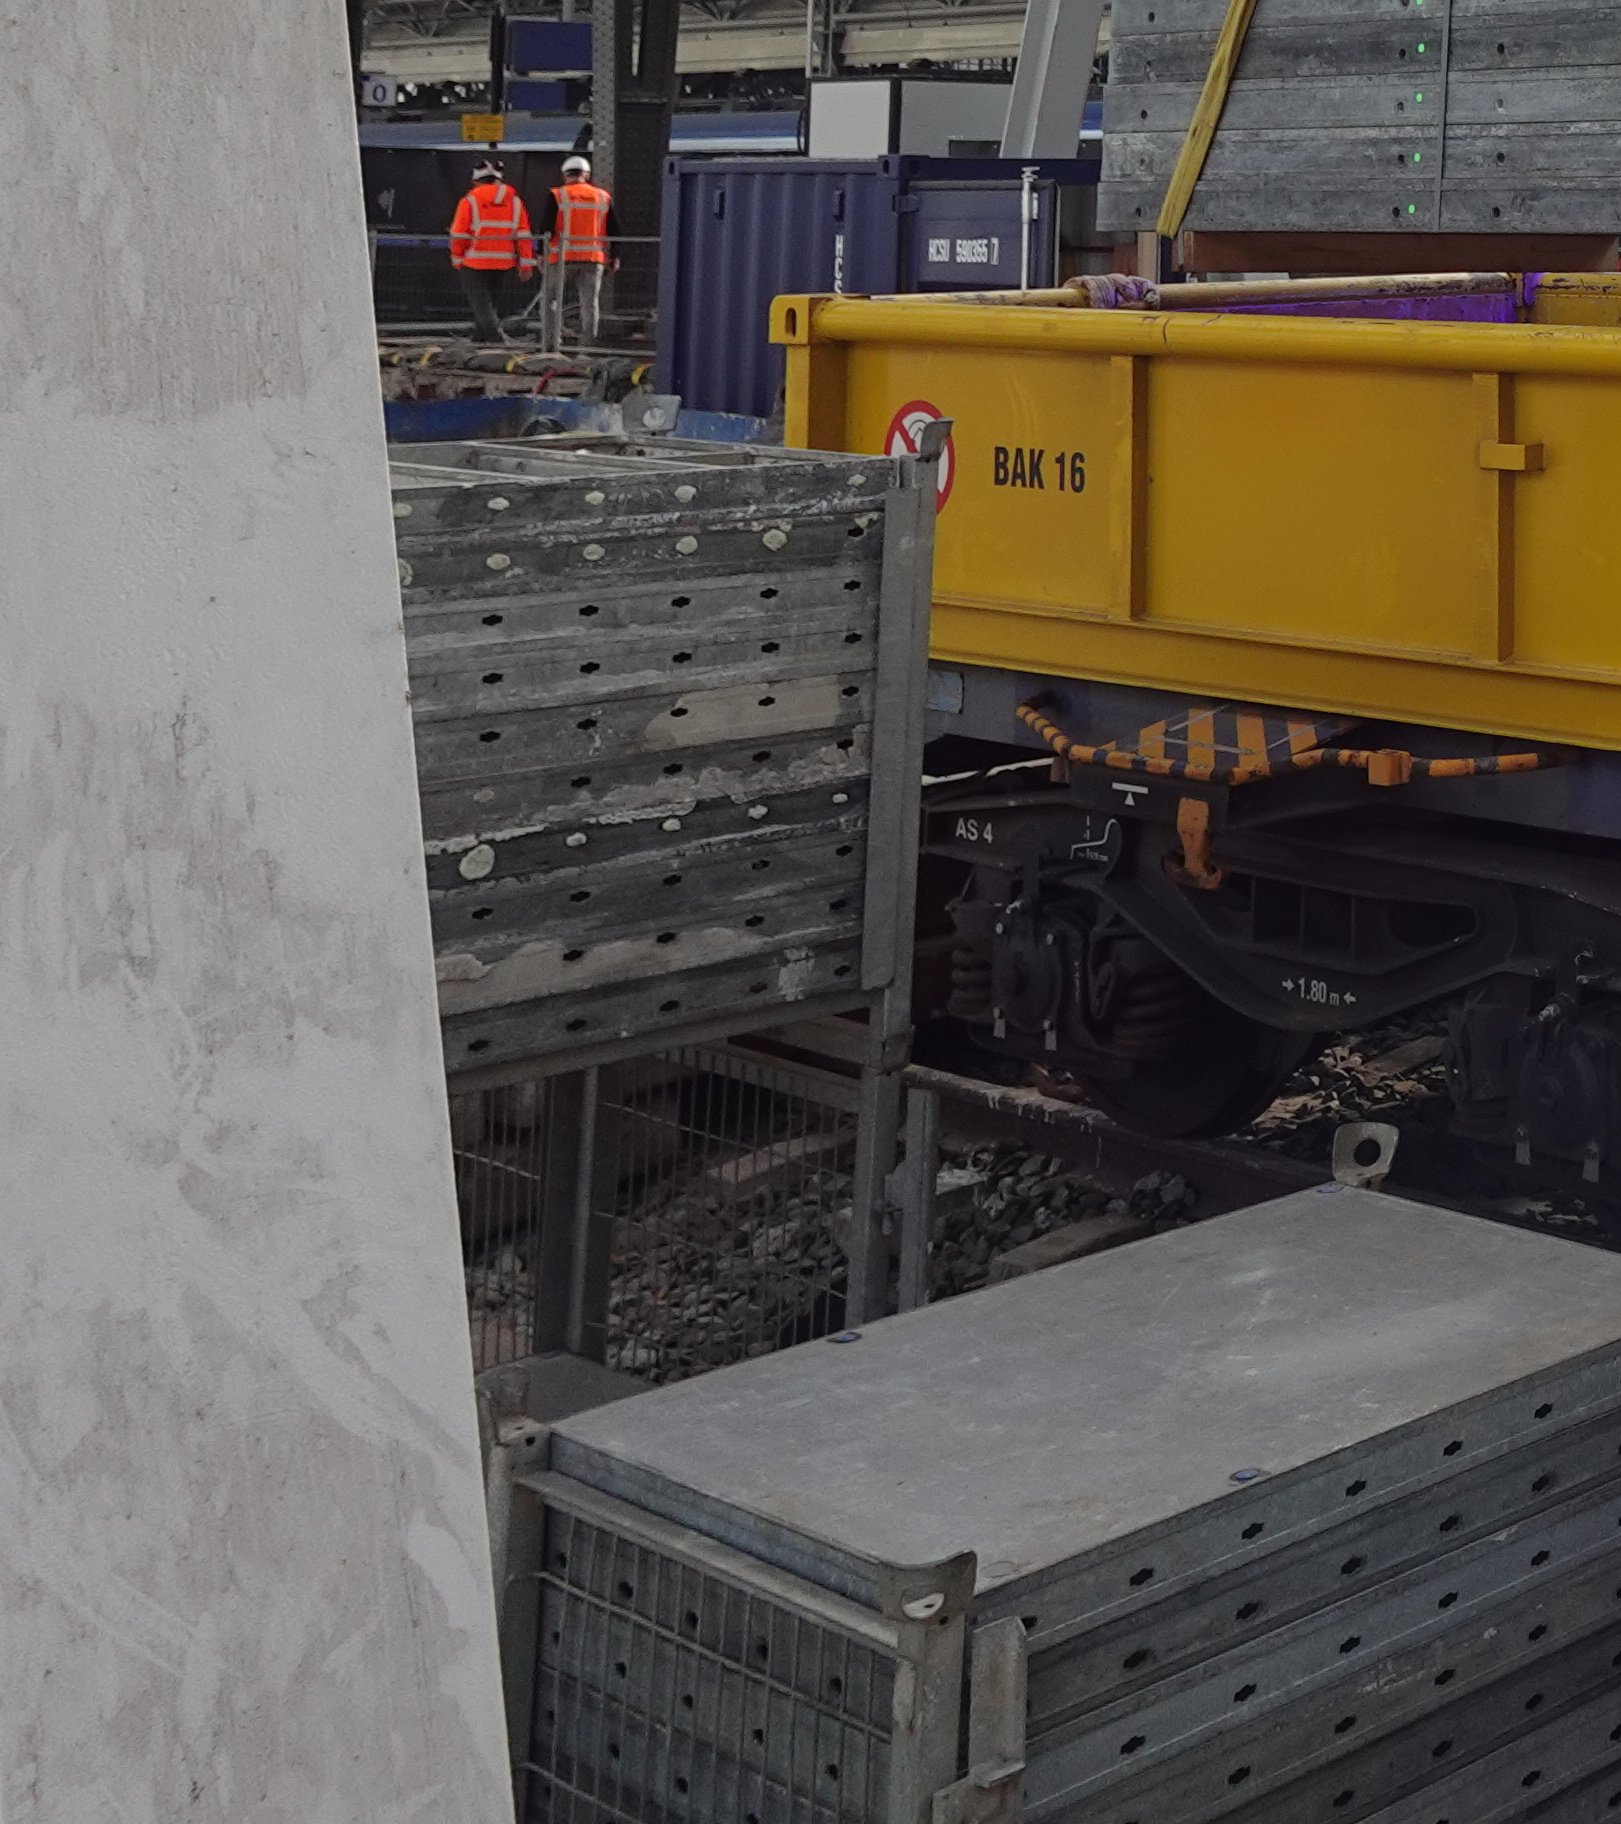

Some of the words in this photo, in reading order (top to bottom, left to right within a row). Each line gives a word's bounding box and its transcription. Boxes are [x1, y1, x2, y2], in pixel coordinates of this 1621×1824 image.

[994, 445, 1045, 490] BAK
[1055, 451, 1086, 493] 16
[955, 817, 979, 841] AS
[983, 823, 993, 843] 4
[1298, 977, 1327, 1003] 1.80
[1329, 991, 1340, 1006] m
